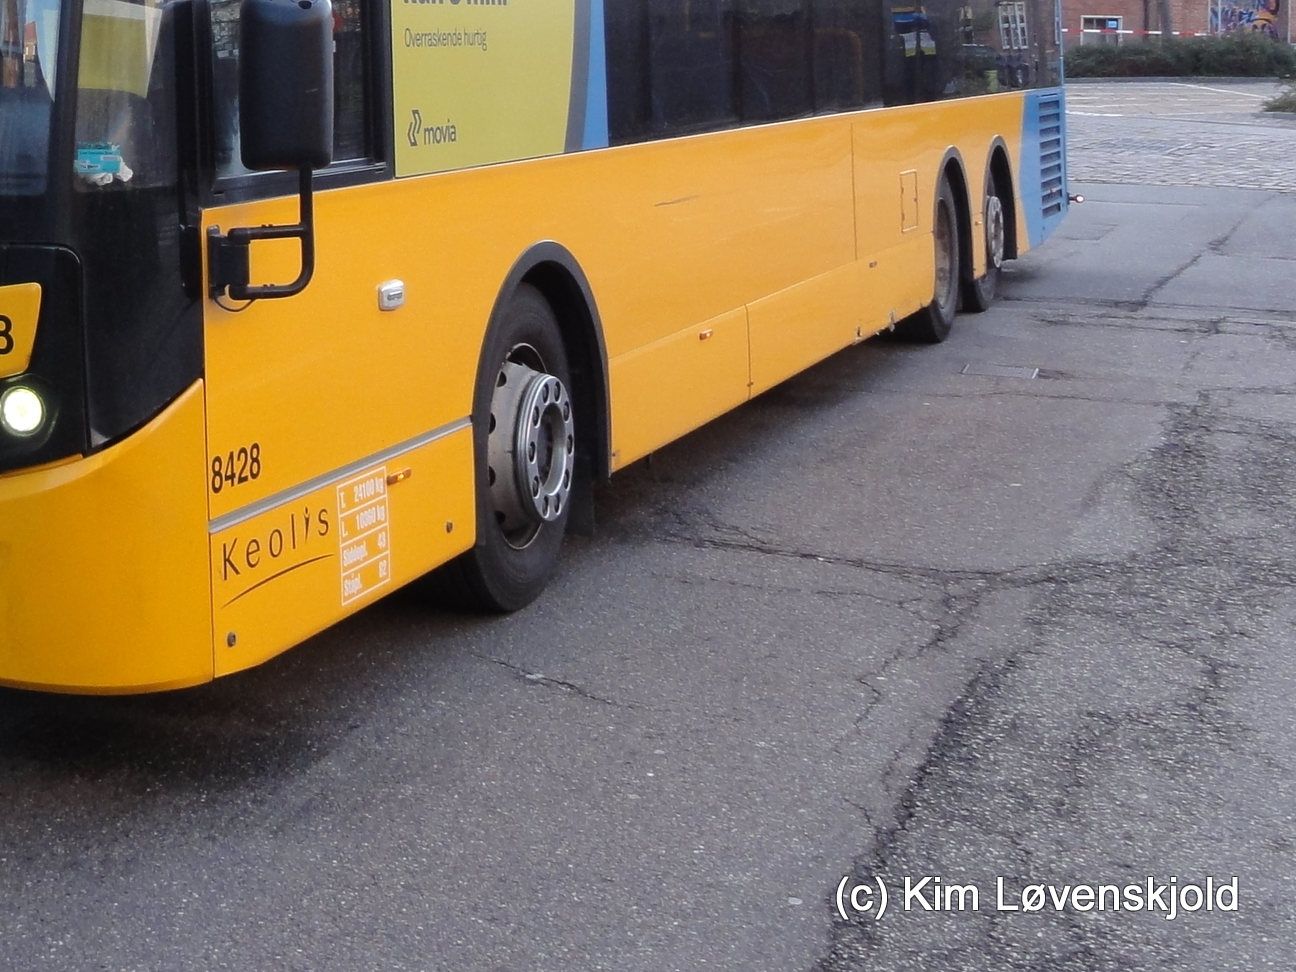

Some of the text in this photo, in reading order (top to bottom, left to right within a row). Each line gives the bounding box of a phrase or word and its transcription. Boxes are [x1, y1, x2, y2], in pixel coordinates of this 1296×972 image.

[404, 28, 487, 51] Overraskende hurtig
[424, 119, 456, 146] movia
[211, 443, 261, 494] 8428
[221, 506, 330, 581] Keolis
